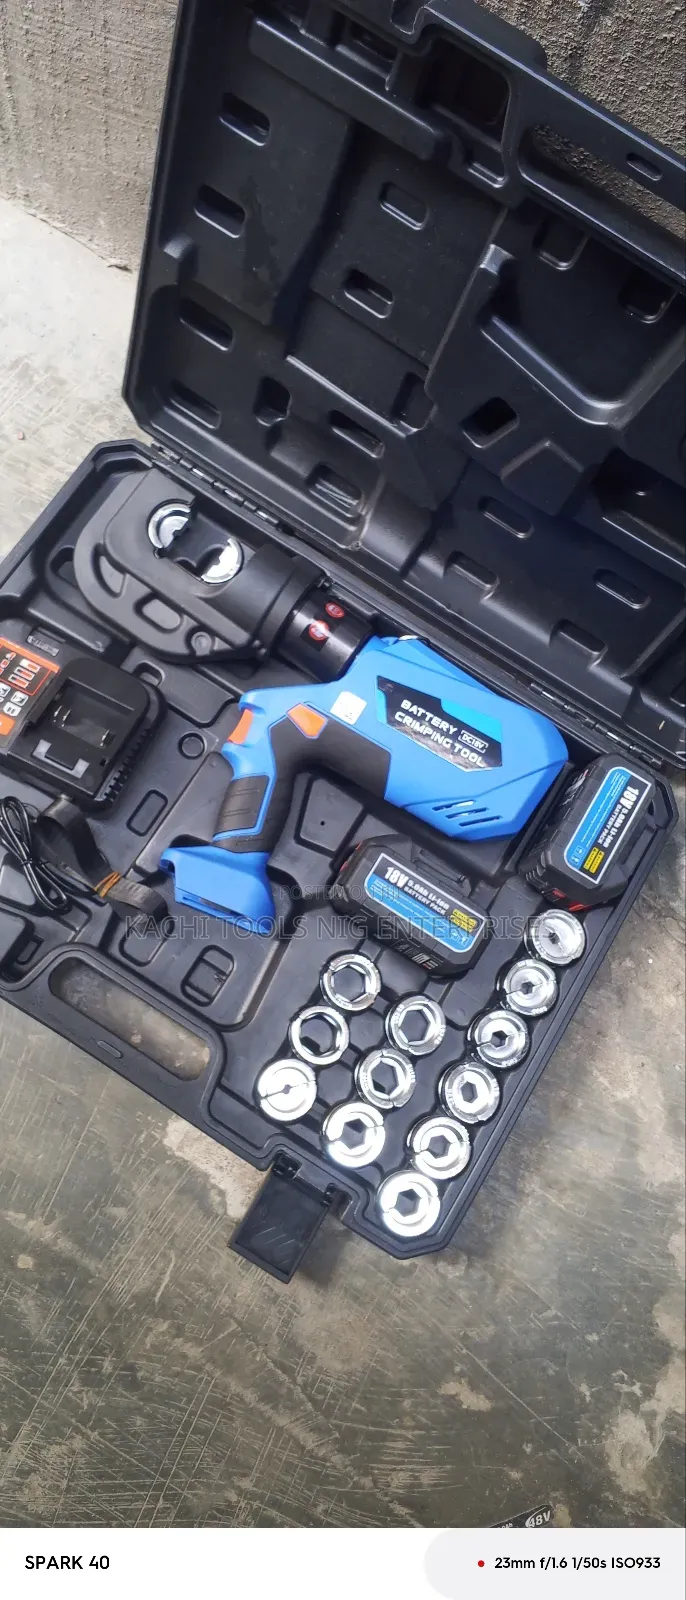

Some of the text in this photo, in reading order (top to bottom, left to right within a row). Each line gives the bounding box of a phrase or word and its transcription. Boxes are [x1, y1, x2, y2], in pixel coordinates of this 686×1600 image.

[394, 711, 485, 767] CRIMPING TOOL
[400, 699, 485, 750] BATTERY DC18V
[619, 785, 639, 810] 18V
[597, 803, 622, 844] BATTERY PACK
[384, 866, 409, 888] 18V
[403, 886, 446, 915] BATTERY PACK
[528, 1510, 551, 1527] 48V
